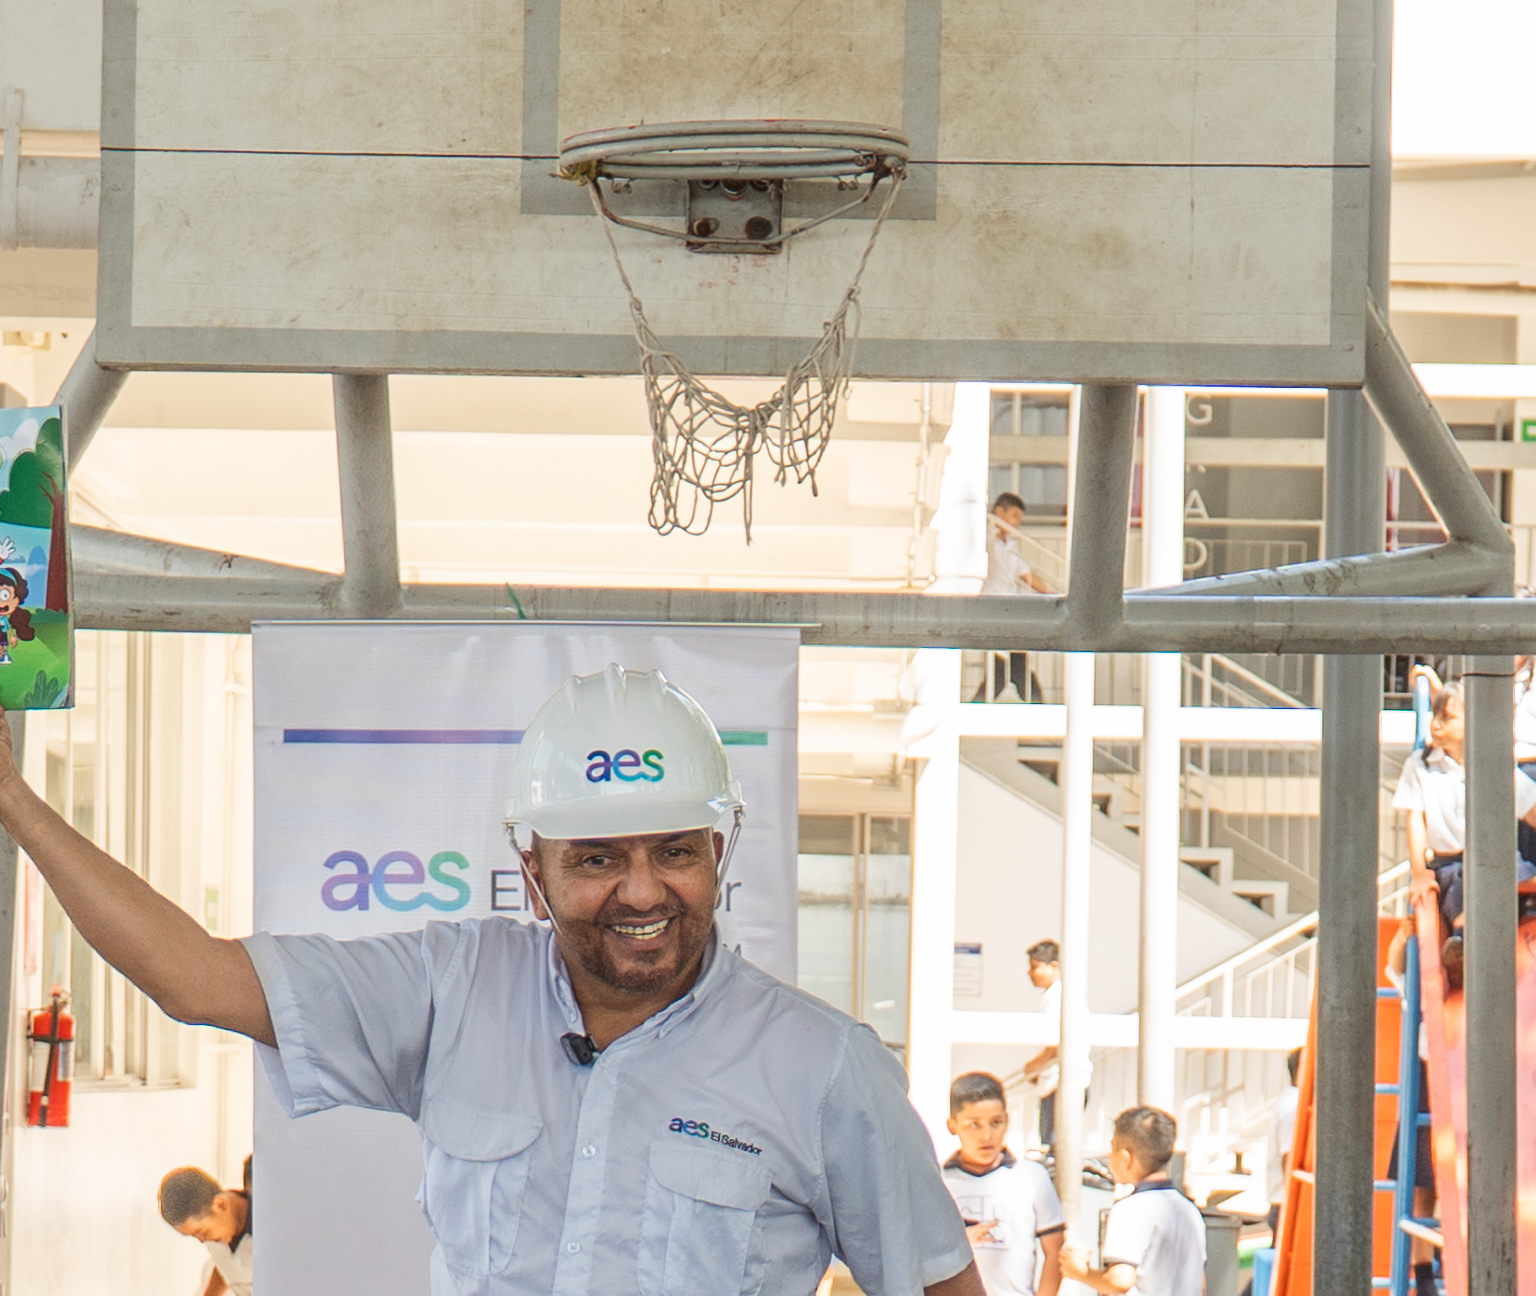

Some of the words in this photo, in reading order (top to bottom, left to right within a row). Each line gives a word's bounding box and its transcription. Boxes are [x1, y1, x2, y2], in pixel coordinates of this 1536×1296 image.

[585, 748, 665, 782] aes
[321, 850, 471, 912] aes
[668, 1117, 710, 1139] aes
[710, 1130, 721, 1143] El
[721, 1134, 763, 1156] Salvador
